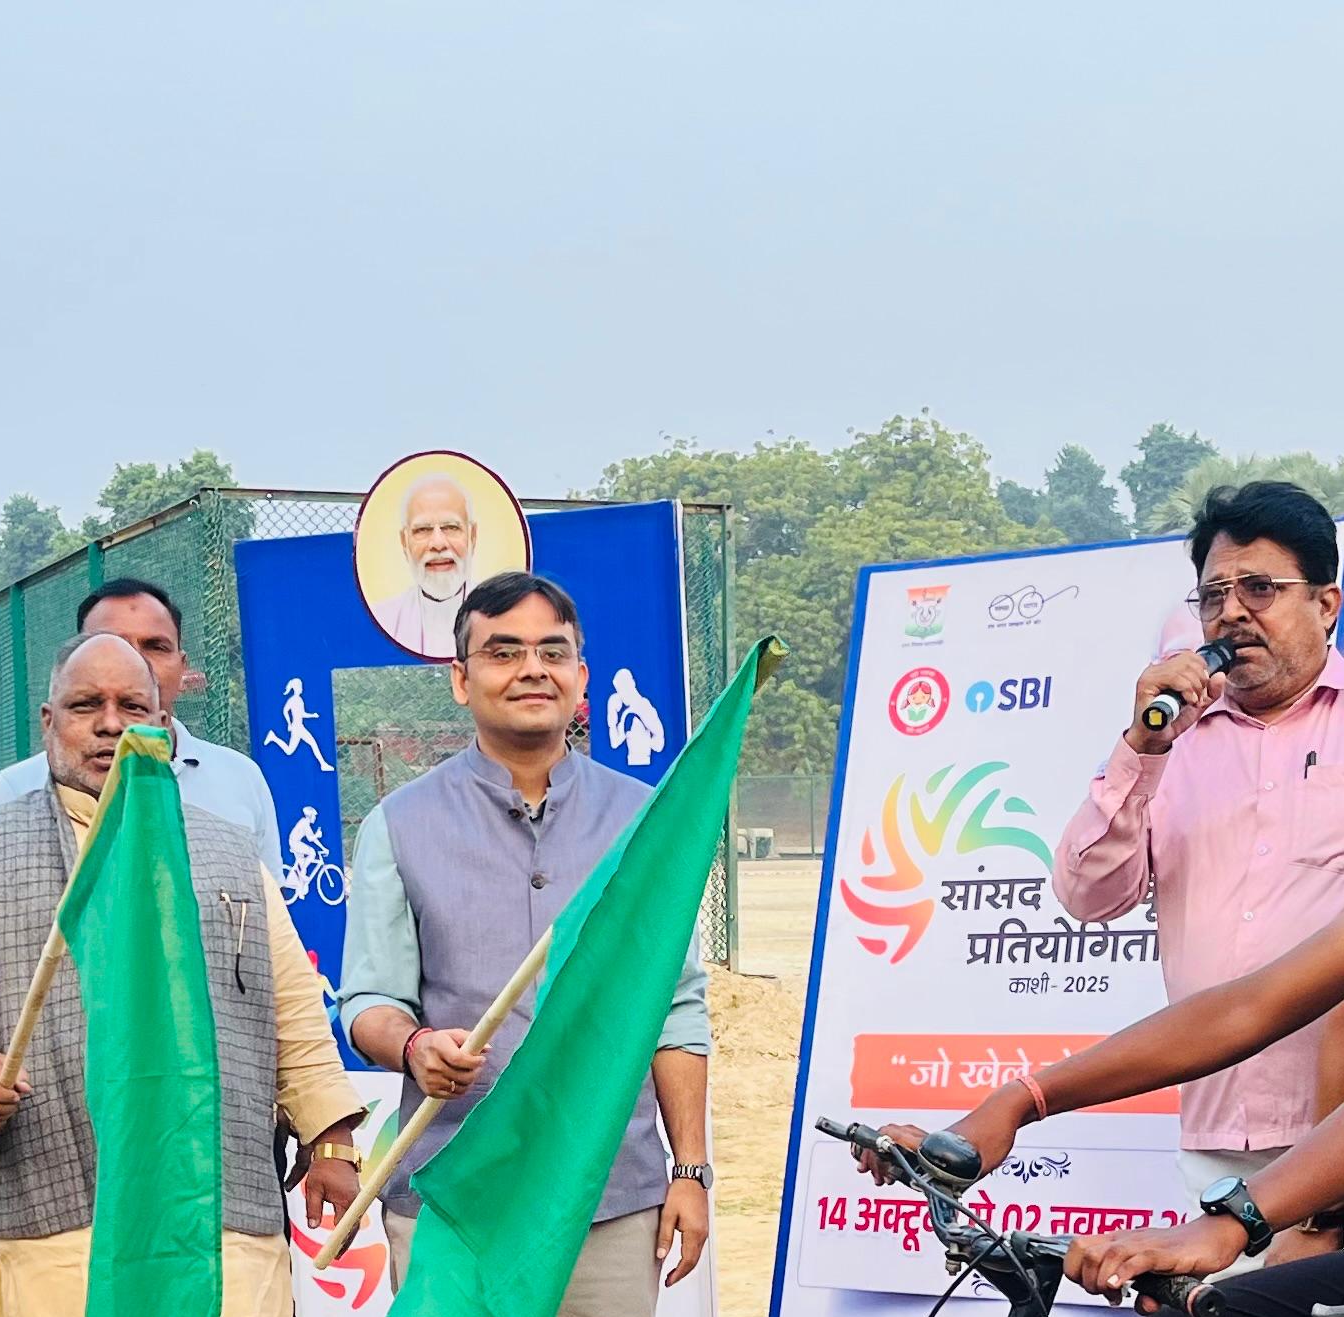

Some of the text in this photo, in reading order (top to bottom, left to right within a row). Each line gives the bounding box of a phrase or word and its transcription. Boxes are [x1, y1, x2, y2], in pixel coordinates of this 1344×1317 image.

[997, 675, 1052, 711] SBI
[941, 865, 1046, 911] सांसद
[967, 917, 1160, 965] प्रतियोगिता
[1063, 975, 1109, 993] 2025
[818, 1196, 847, 1231] 14
[855, 1198, 937, 1252] अक्टू
